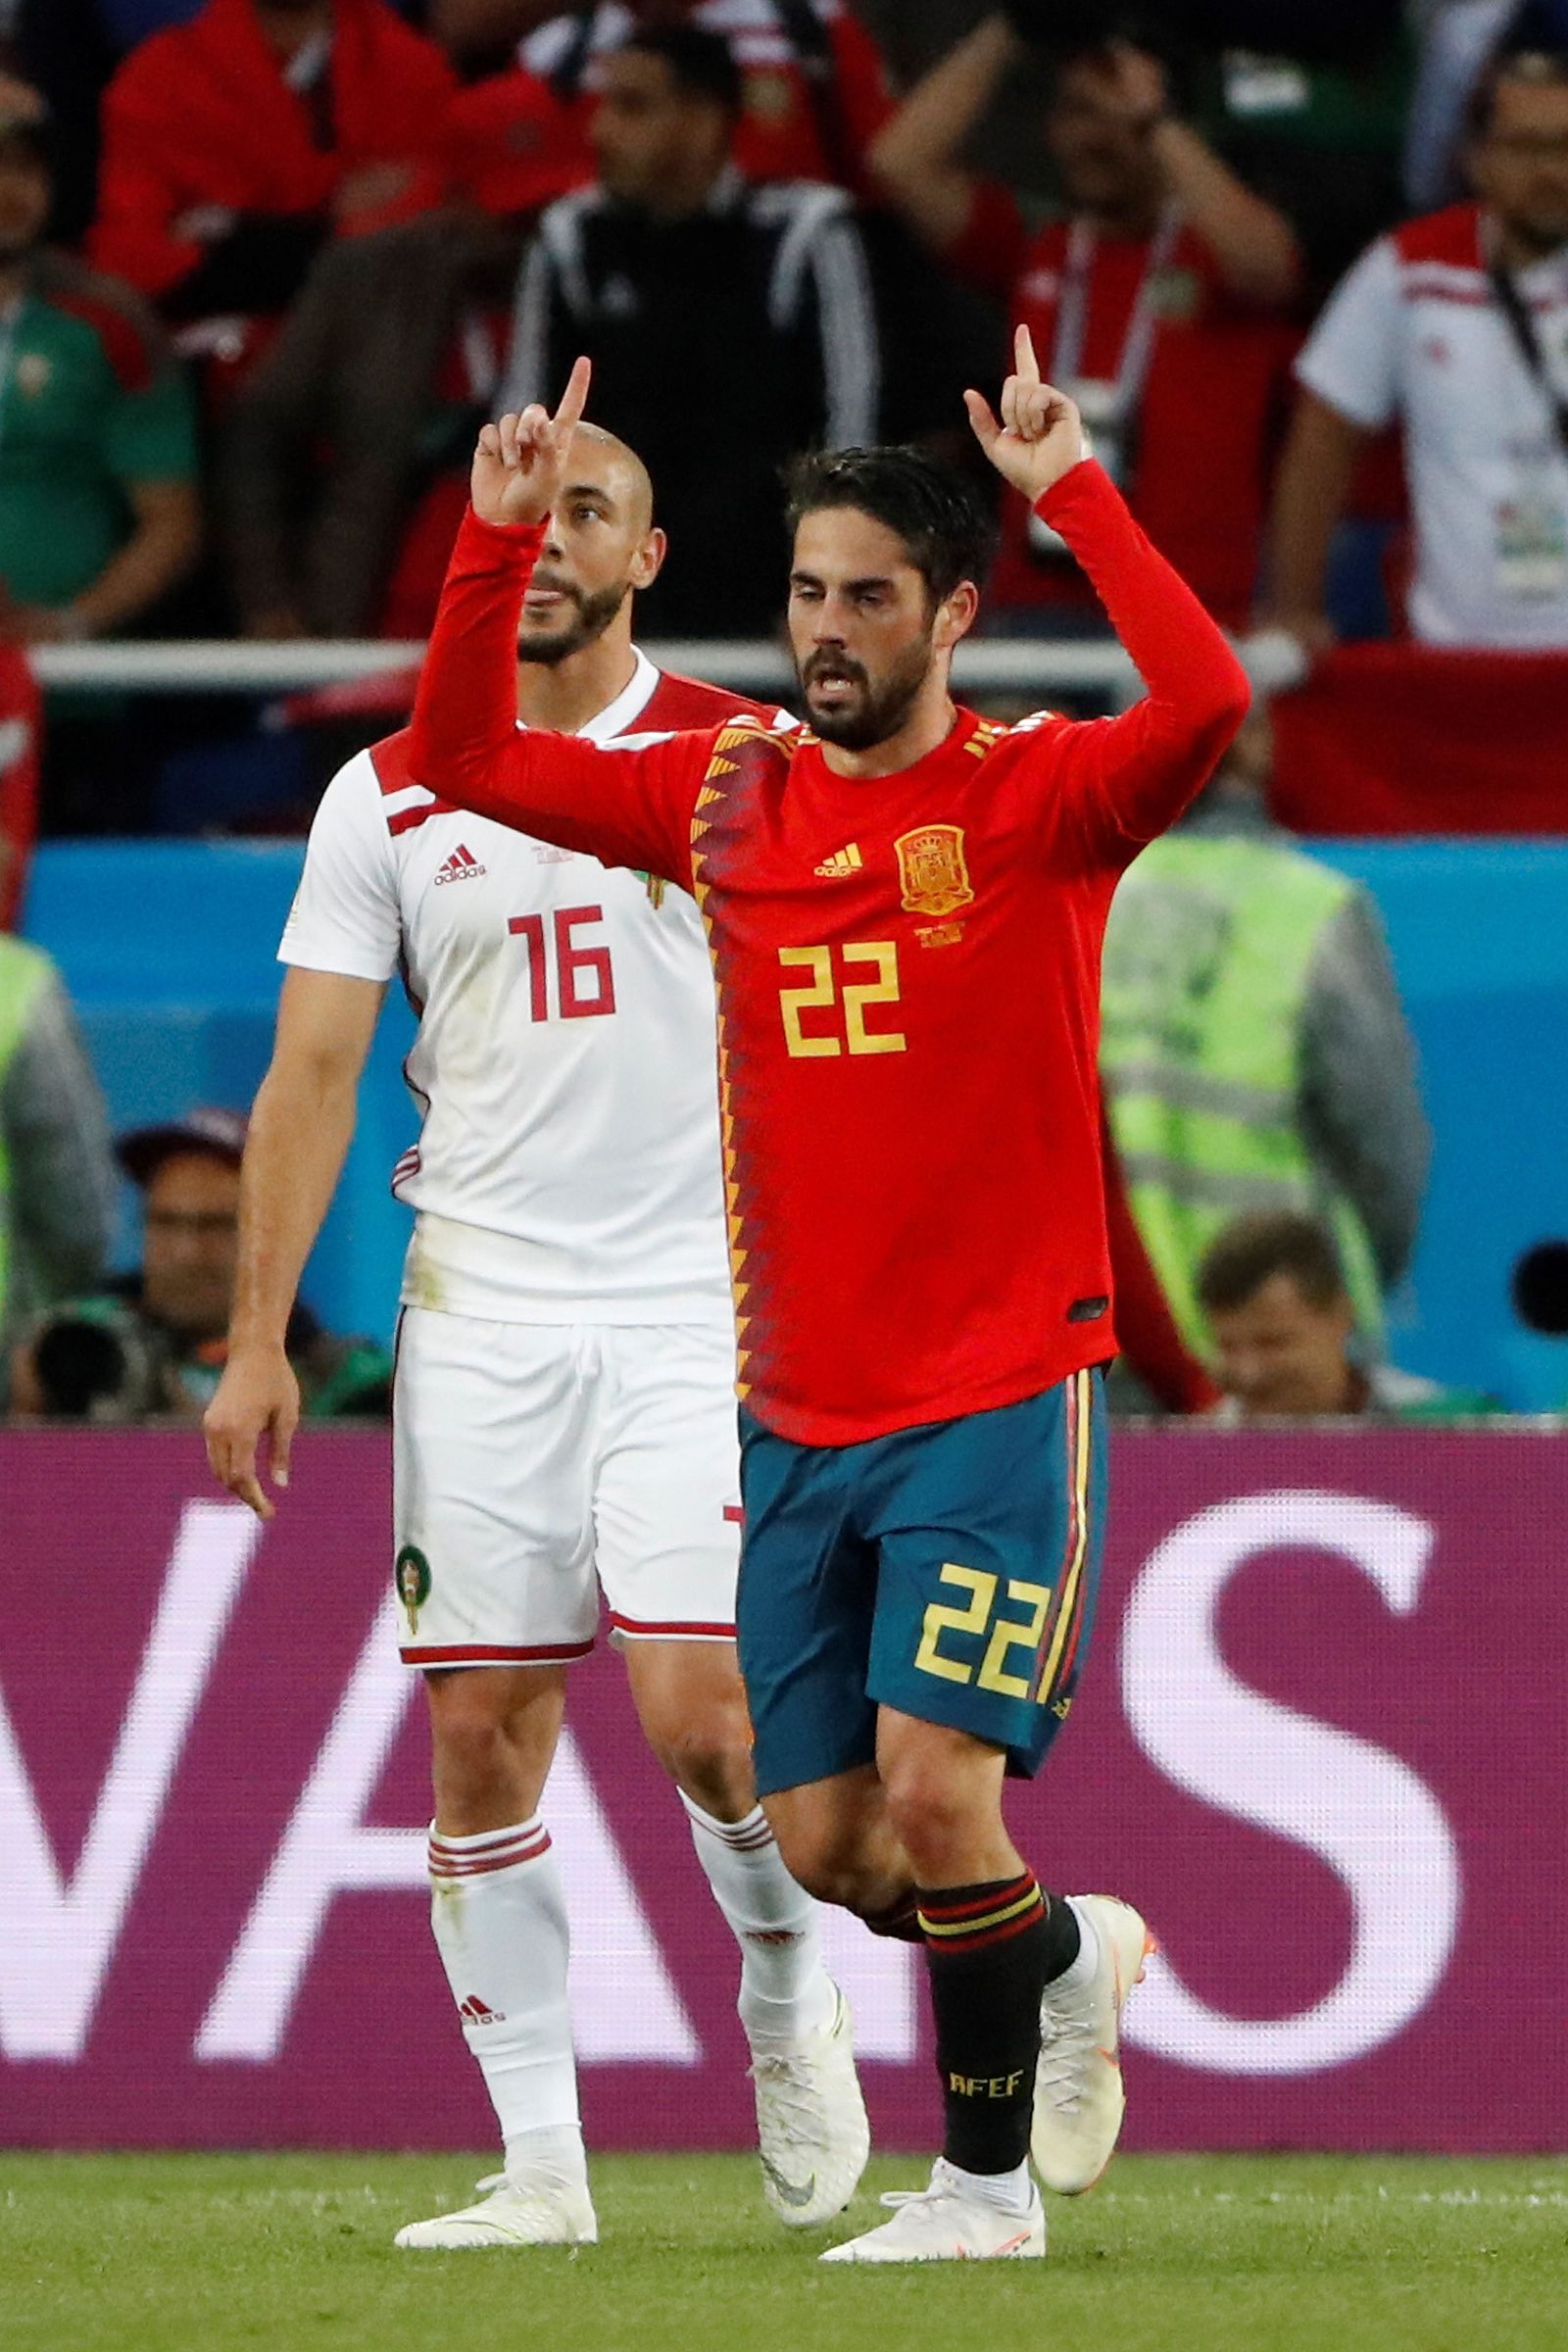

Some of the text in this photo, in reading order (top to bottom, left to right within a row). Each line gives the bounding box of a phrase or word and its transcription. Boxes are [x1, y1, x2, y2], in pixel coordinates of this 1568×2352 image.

[434, 864, 487, 886] adidas
[508, 904, 616, 1023] 16
[778, 940, 907, 1058] 22
[914, 1562, 1052, 1699] 22
[950, 2069, 1025, 2097] RFEF
